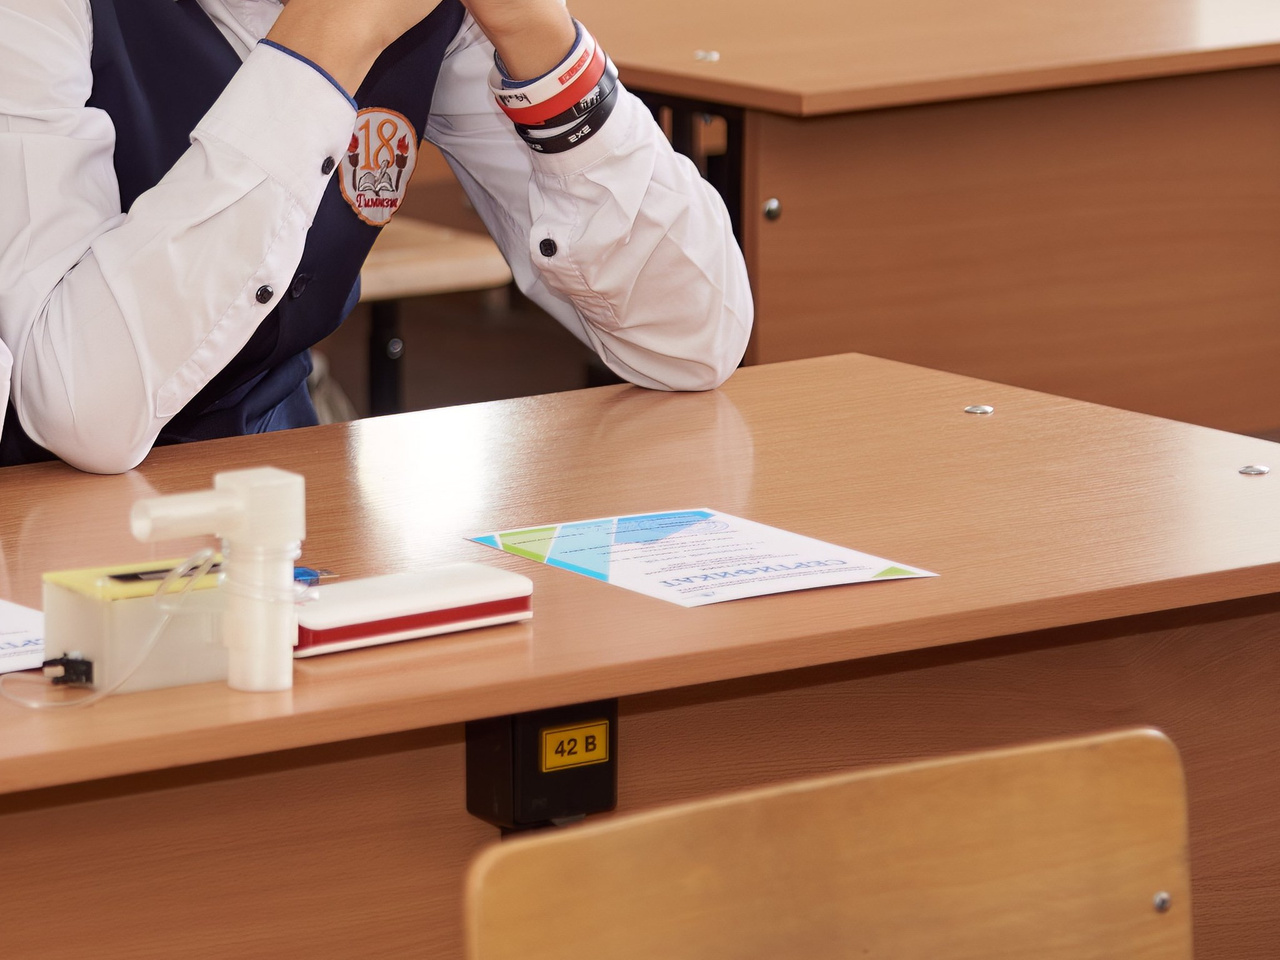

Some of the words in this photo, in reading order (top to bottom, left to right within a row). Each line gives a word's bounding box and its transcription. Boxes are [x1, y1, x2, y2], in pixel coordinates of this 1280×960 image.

[358, 118, 399, 171] 18
[658, 559, 847, 588] СЕРТИФИКАТ
[554, 738, 579, 757] 42
